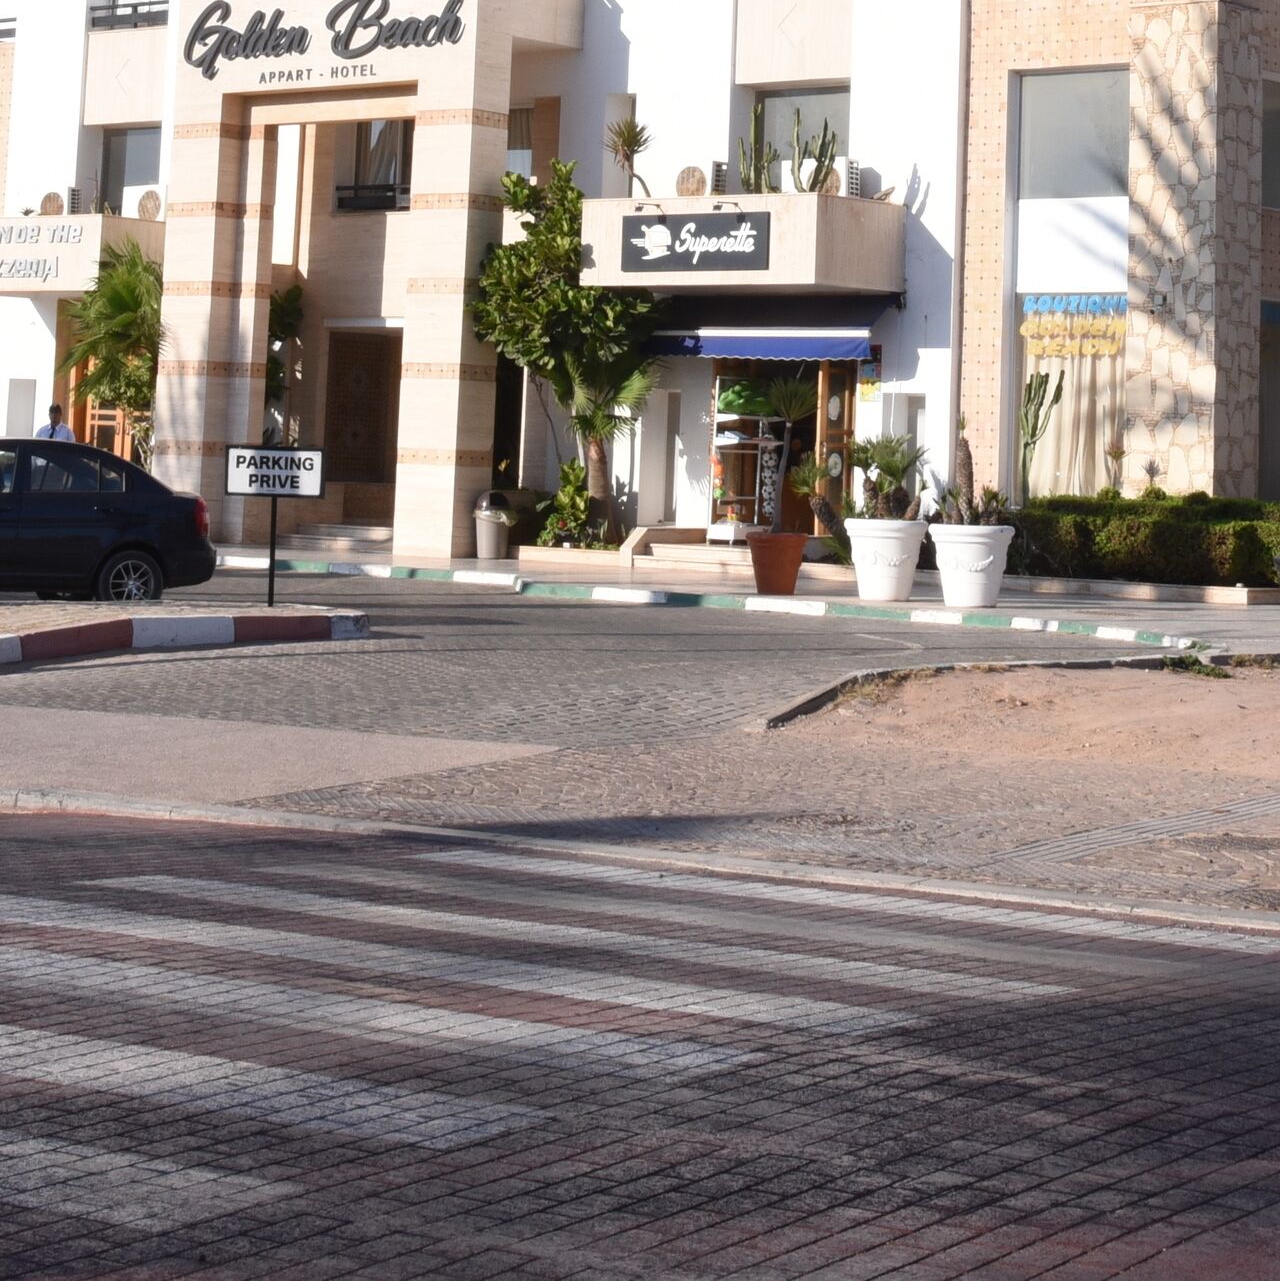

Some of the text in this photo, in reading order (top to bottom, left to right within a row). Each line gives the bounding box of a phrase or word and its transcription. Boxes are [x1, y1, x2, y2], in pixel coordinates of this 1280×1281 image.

[183, 0, 312, 80] Golden
[259, 69, 313, 84] APPART
[331, 64, 376, 78] HOTEL
[674, 222, 757, 265] Superette
[236, 455, 314, 471] PARKING
[248, 474, 300, 489] PRIVE
